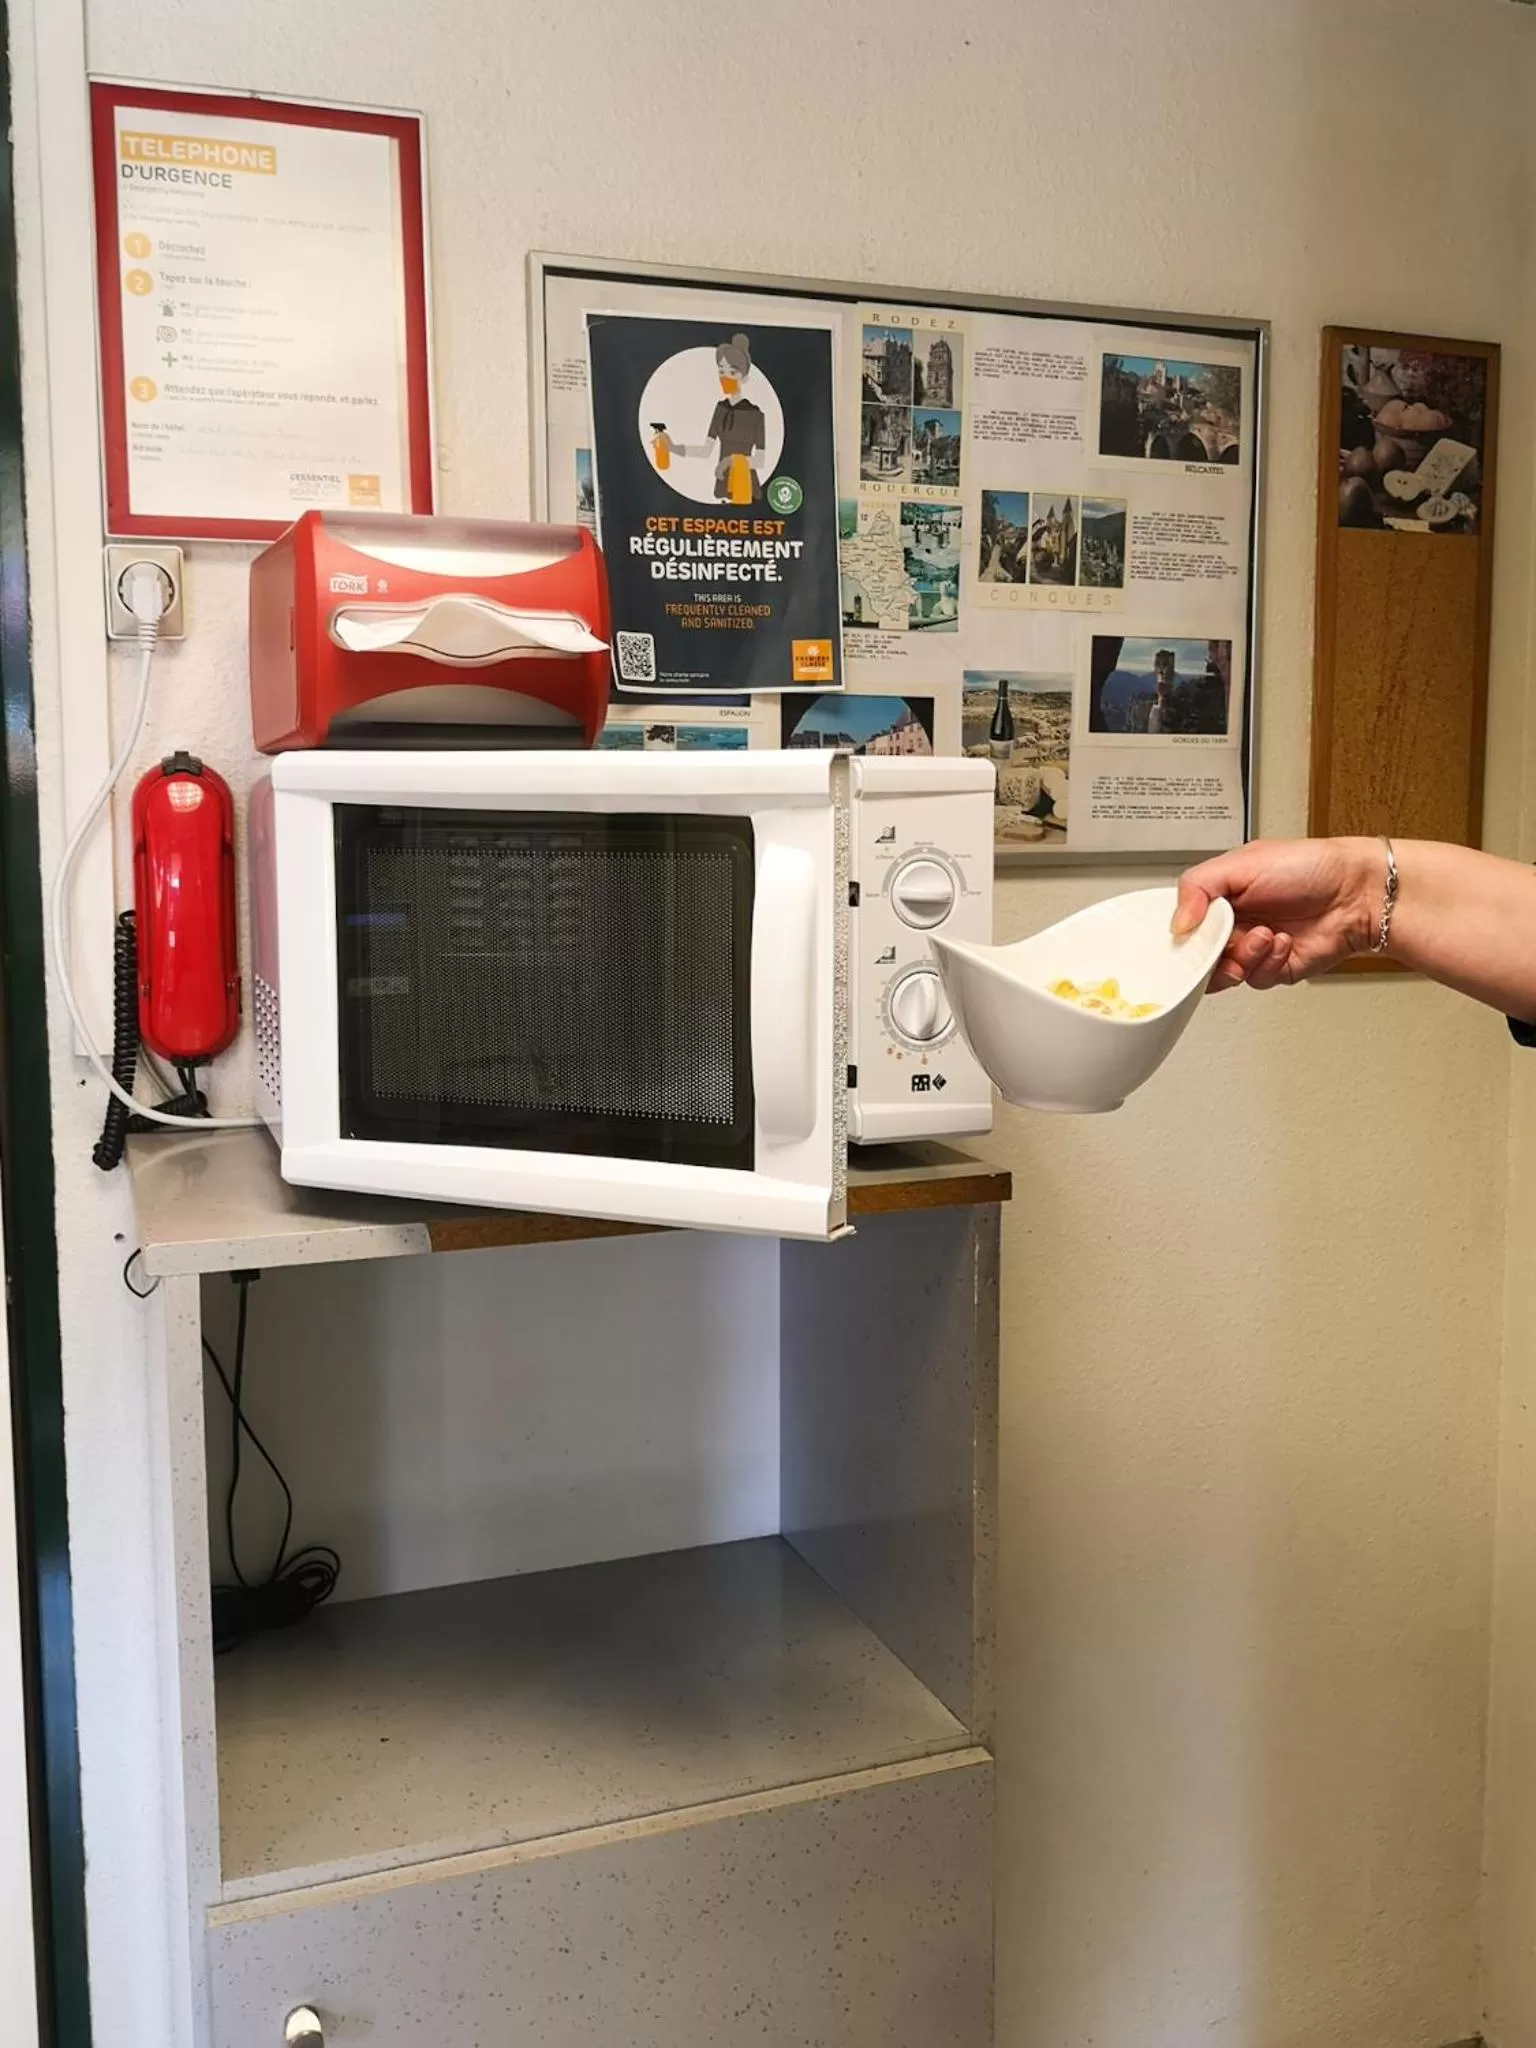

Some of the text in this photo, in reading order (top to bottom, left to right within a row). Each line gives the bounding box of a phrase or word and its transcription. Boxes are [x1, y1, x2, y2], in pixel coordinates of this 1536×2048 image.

[124, 136, 273, 169] TELEPHONE
[121, 163, 233, 188] D'URGENCE
[134, 275, 145, 293] 2
[872, 312, 956, 330] RODEZ
[646, 516, 786, 536] CET ESPACE EST
[629, 532, 804, 560] RÉGULIÈREMENT
[650, 557, 783, 583] DÉSINFECTÉ.
[332, 579, 365, 592] TORK
[694, 593, 742, 603] THIS AREA IS
[989, 588, 1113, 607] CONQUES
[665, 604, 771, 617] FREQUENTLY CLEANED
[681, 617, 756, 630] AND SANITIZED.
